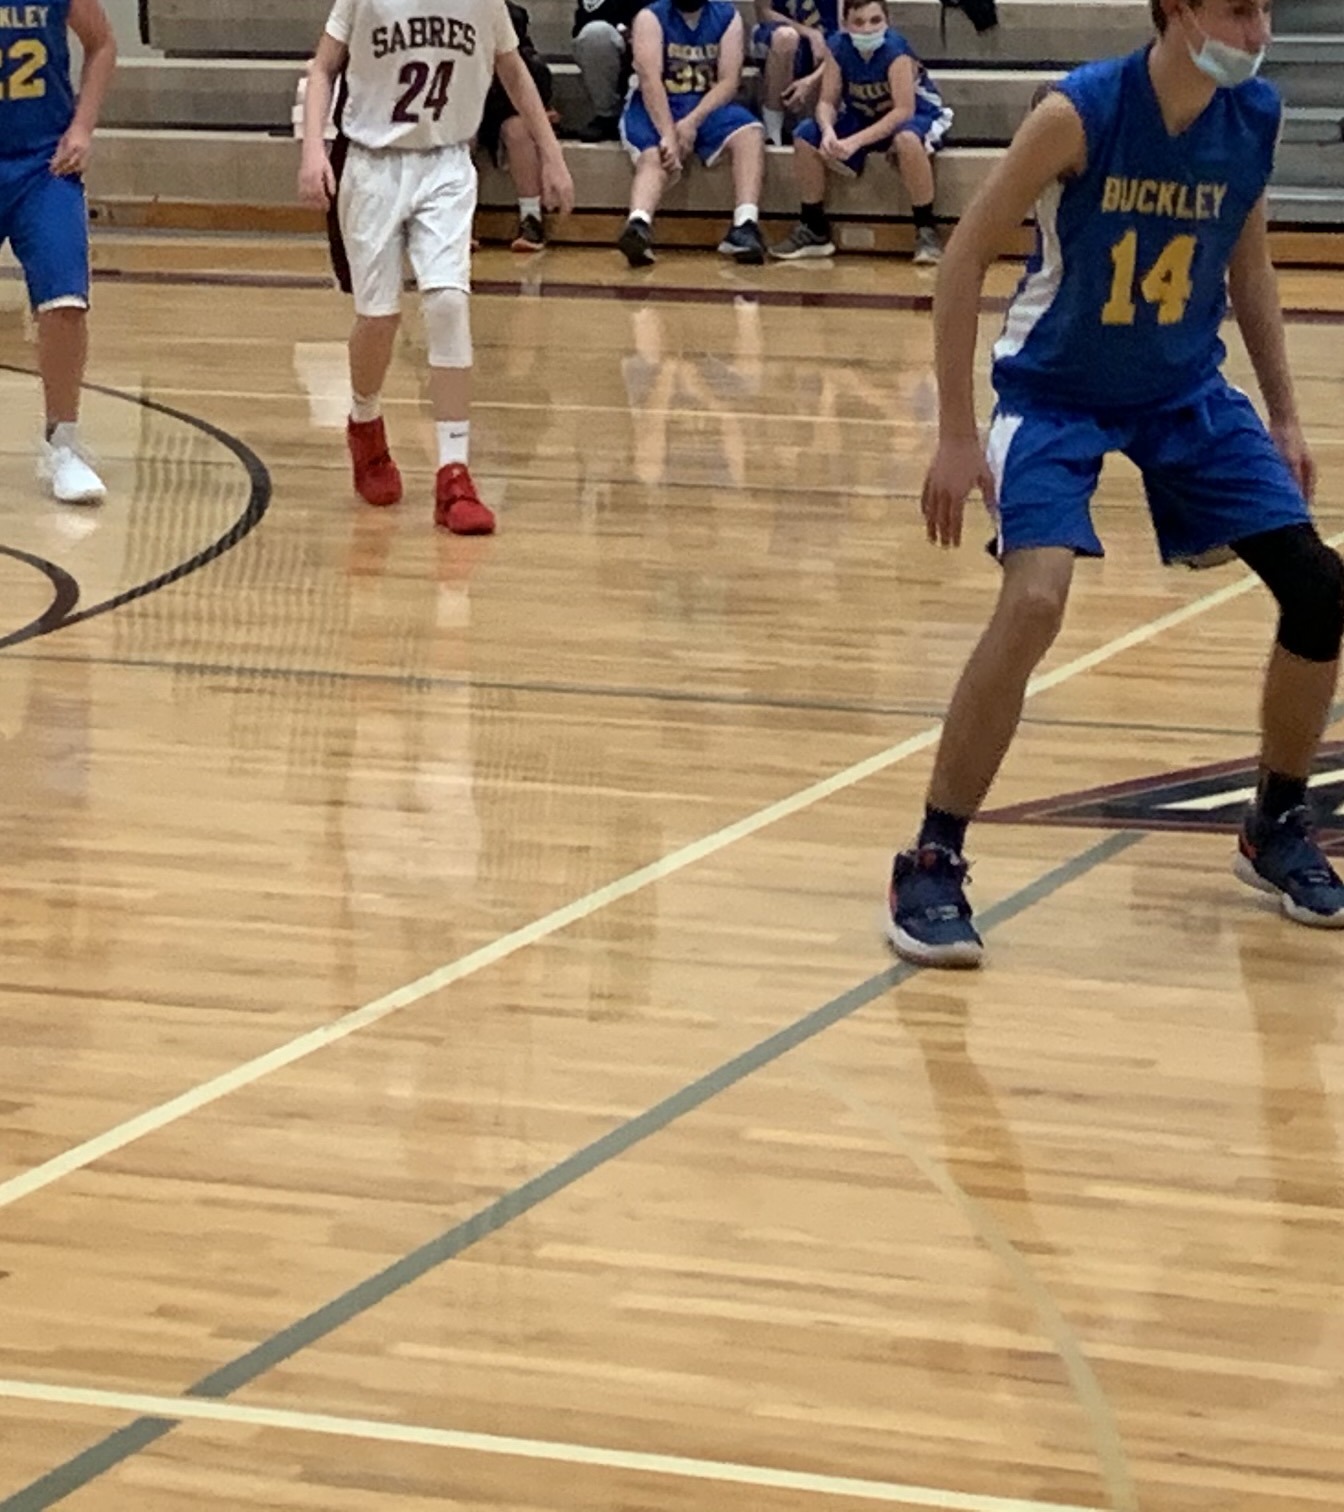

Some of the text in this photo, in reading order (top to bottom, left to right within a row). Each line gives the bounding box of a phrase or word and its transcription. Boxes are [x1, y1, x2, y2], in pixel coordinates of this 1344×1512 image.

[371, 15, 477, 58] SABRES
[391, 60, 456, 124] 24
[1101, 176, 1228, 220] BUCKLEY
[1101, 226, 1198, 326] 14
